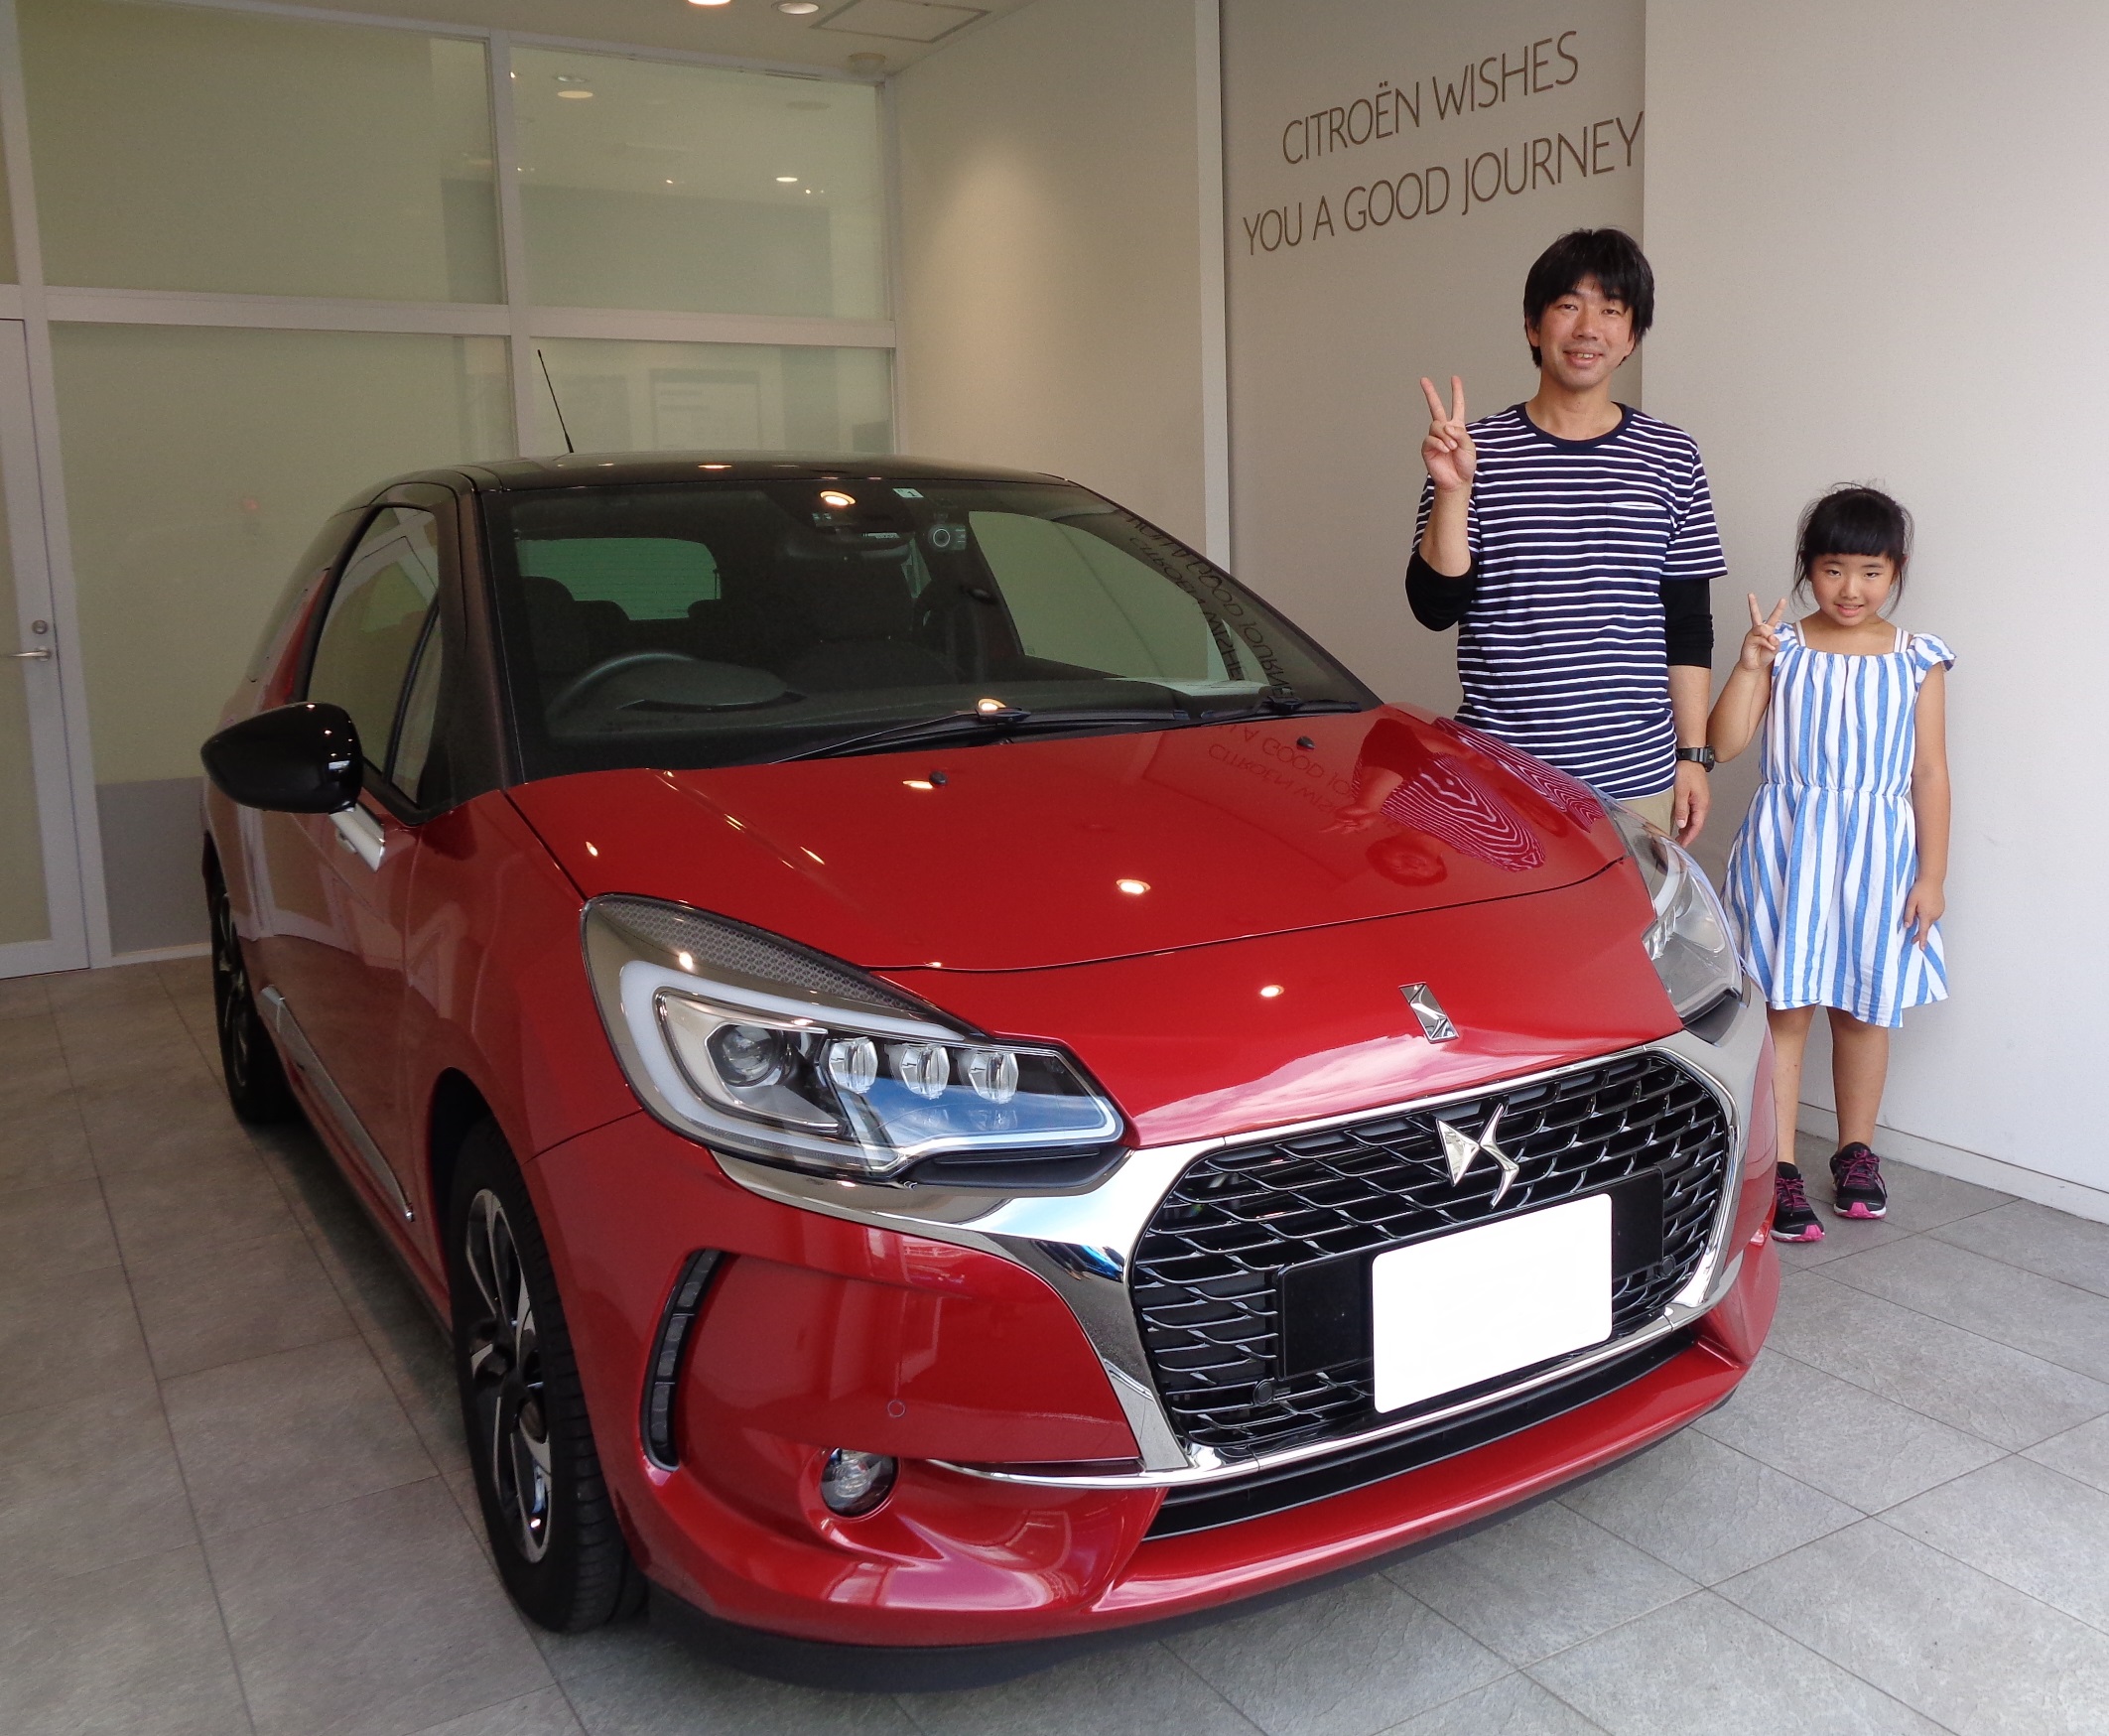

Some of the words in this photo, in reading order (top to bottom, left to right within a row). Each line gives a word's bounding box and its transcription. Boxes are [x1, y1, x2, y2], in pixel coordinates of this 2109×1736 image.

[1282, 80, 1420, 165] CITROËN
[1432, 30, 1580, 121] WISHES
[1243, 201, 1303, 256] YOU
[1313, 196, 1335, 241] A
[1344, 166, 1450, 232] GOOD
[1461, 110, 1645, 216] JOURNEY
